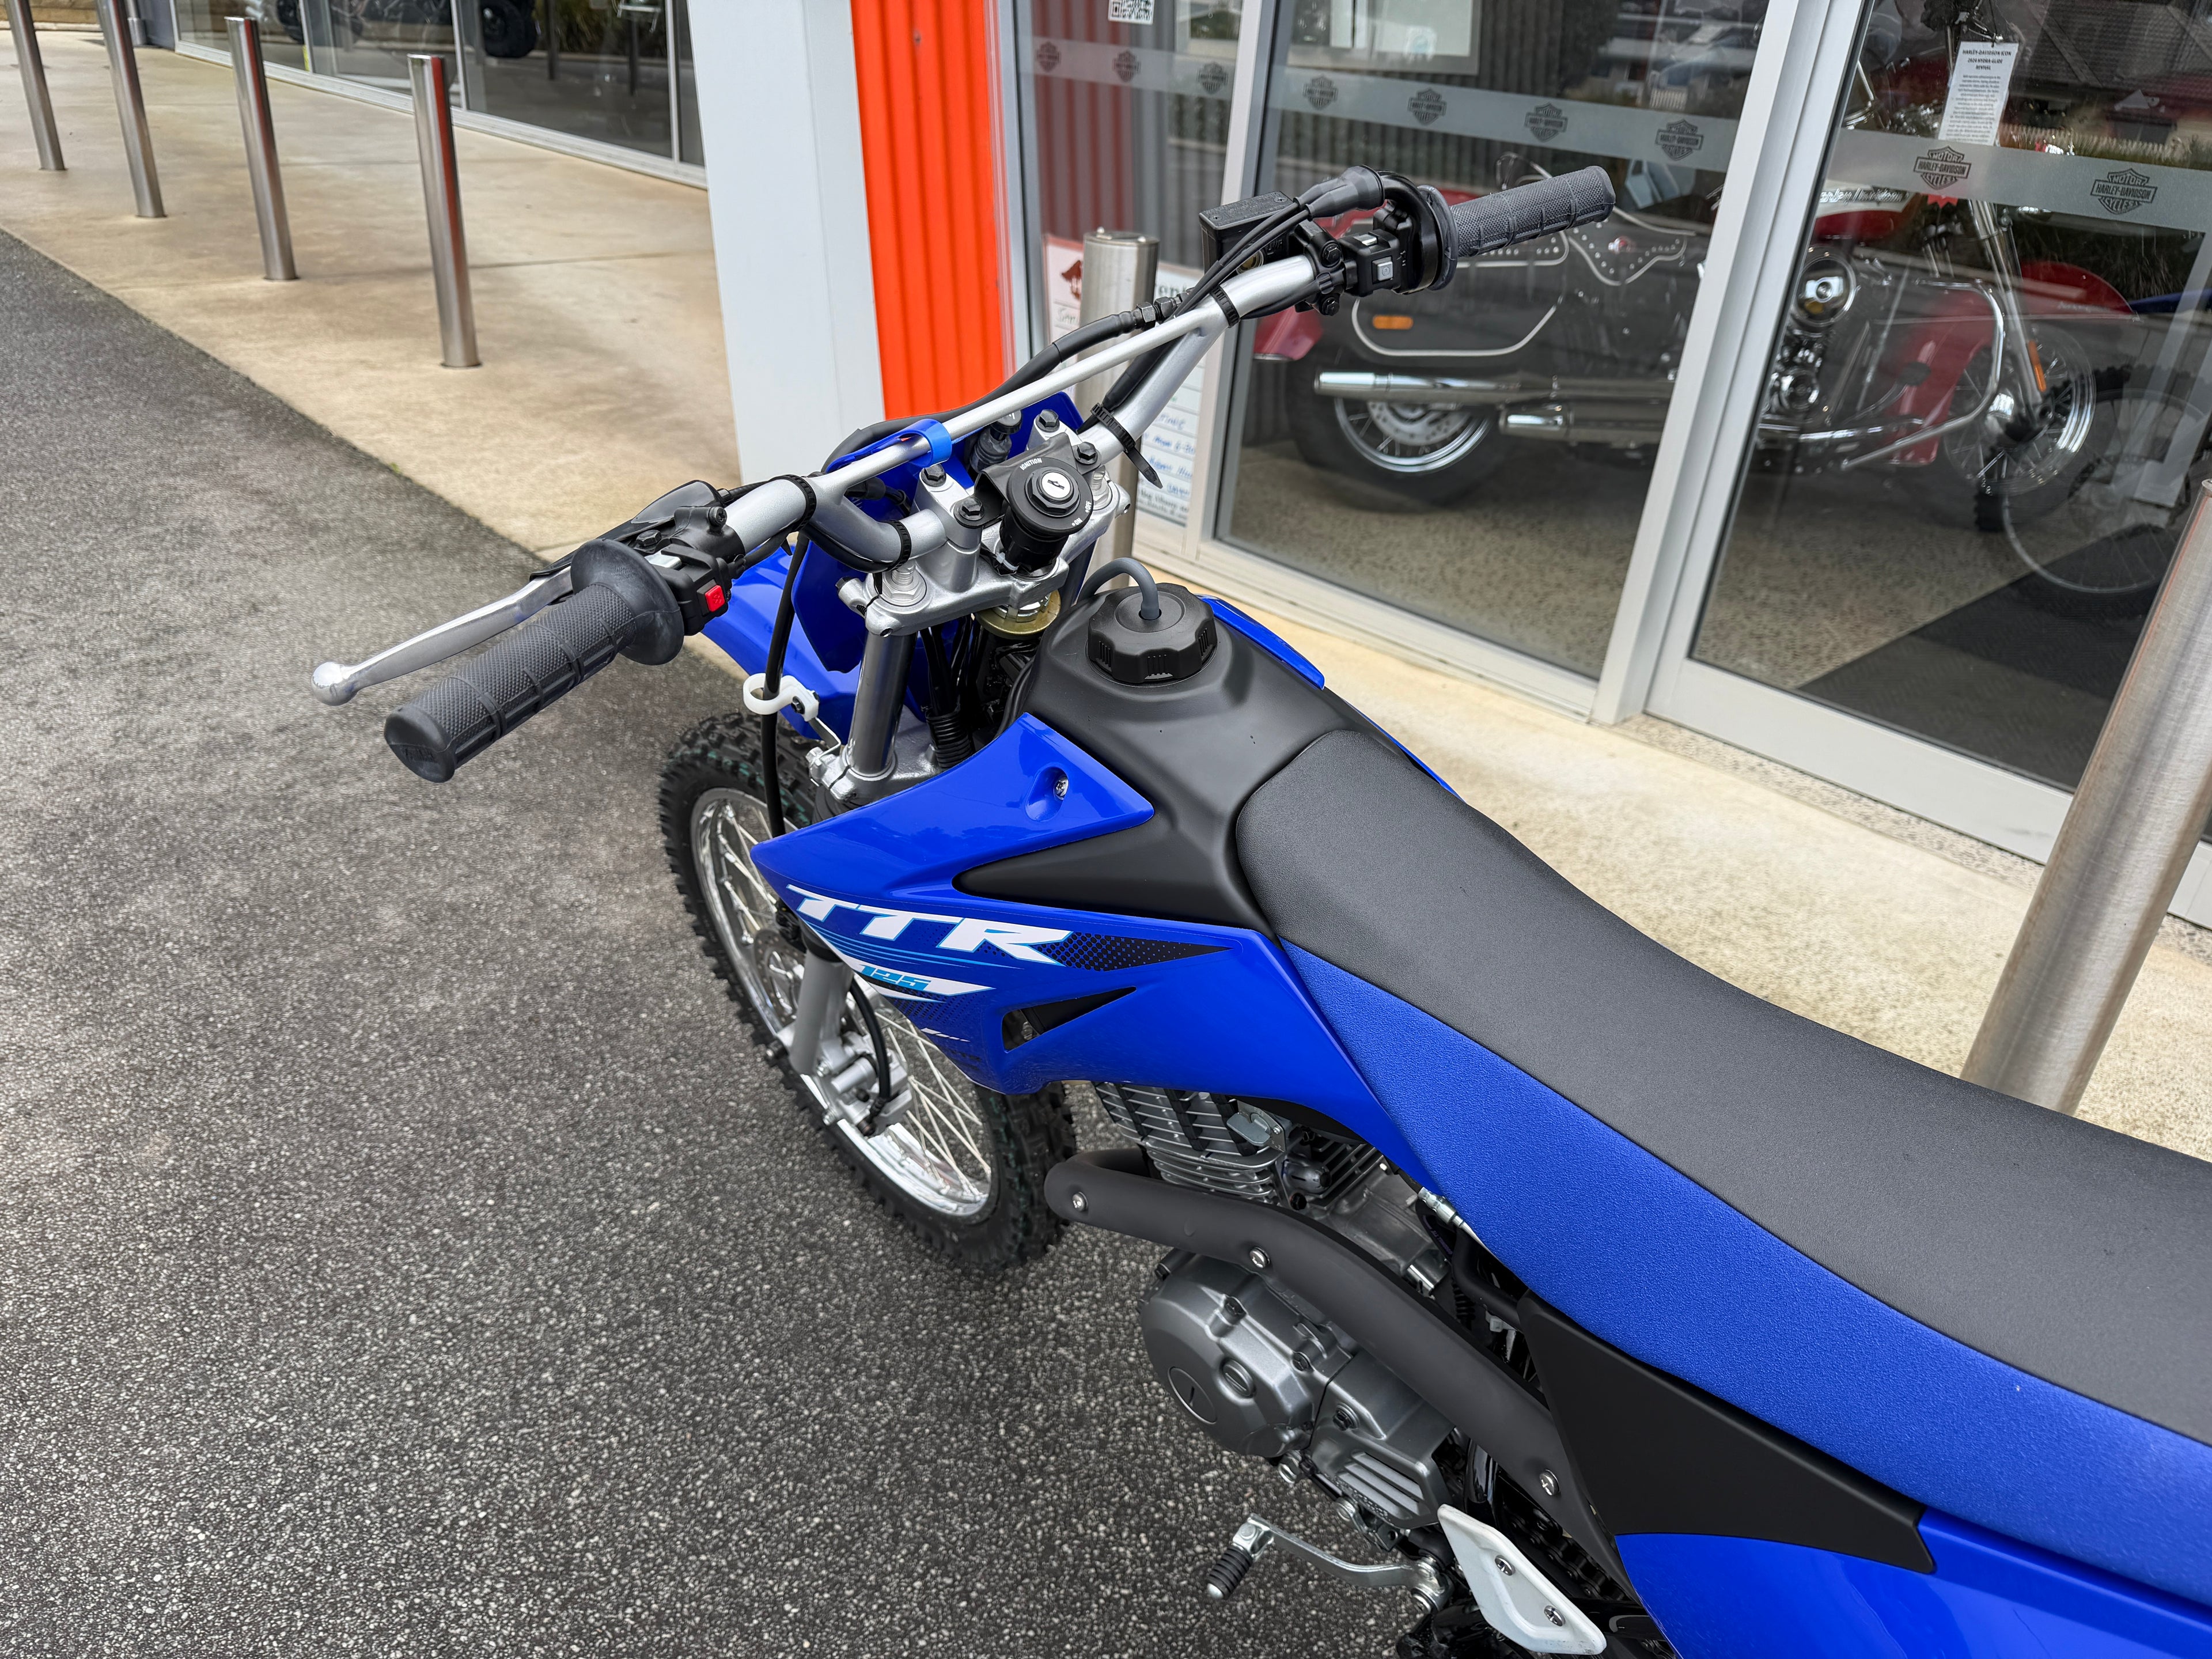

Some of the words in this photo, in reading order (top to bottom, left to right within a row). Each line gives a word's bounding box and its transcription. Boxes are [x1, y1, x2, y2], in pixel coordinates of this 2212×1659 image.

[1932, 151, 1959, 162] MOTOR
[1918, 160, 1967, 175] HARLEY-DAVIDSON
[2112, 173, 2143, 185] MOTOR
[2096, 183, 2152, 200] HARLEY-DAVIDSON
[2104, 197, 2135, 211] CYCLES
[1020, 457, 1043, 471] IGNITION
[786, 884, 1074, 967] TTR
[861, 965, 932, 991] 125
